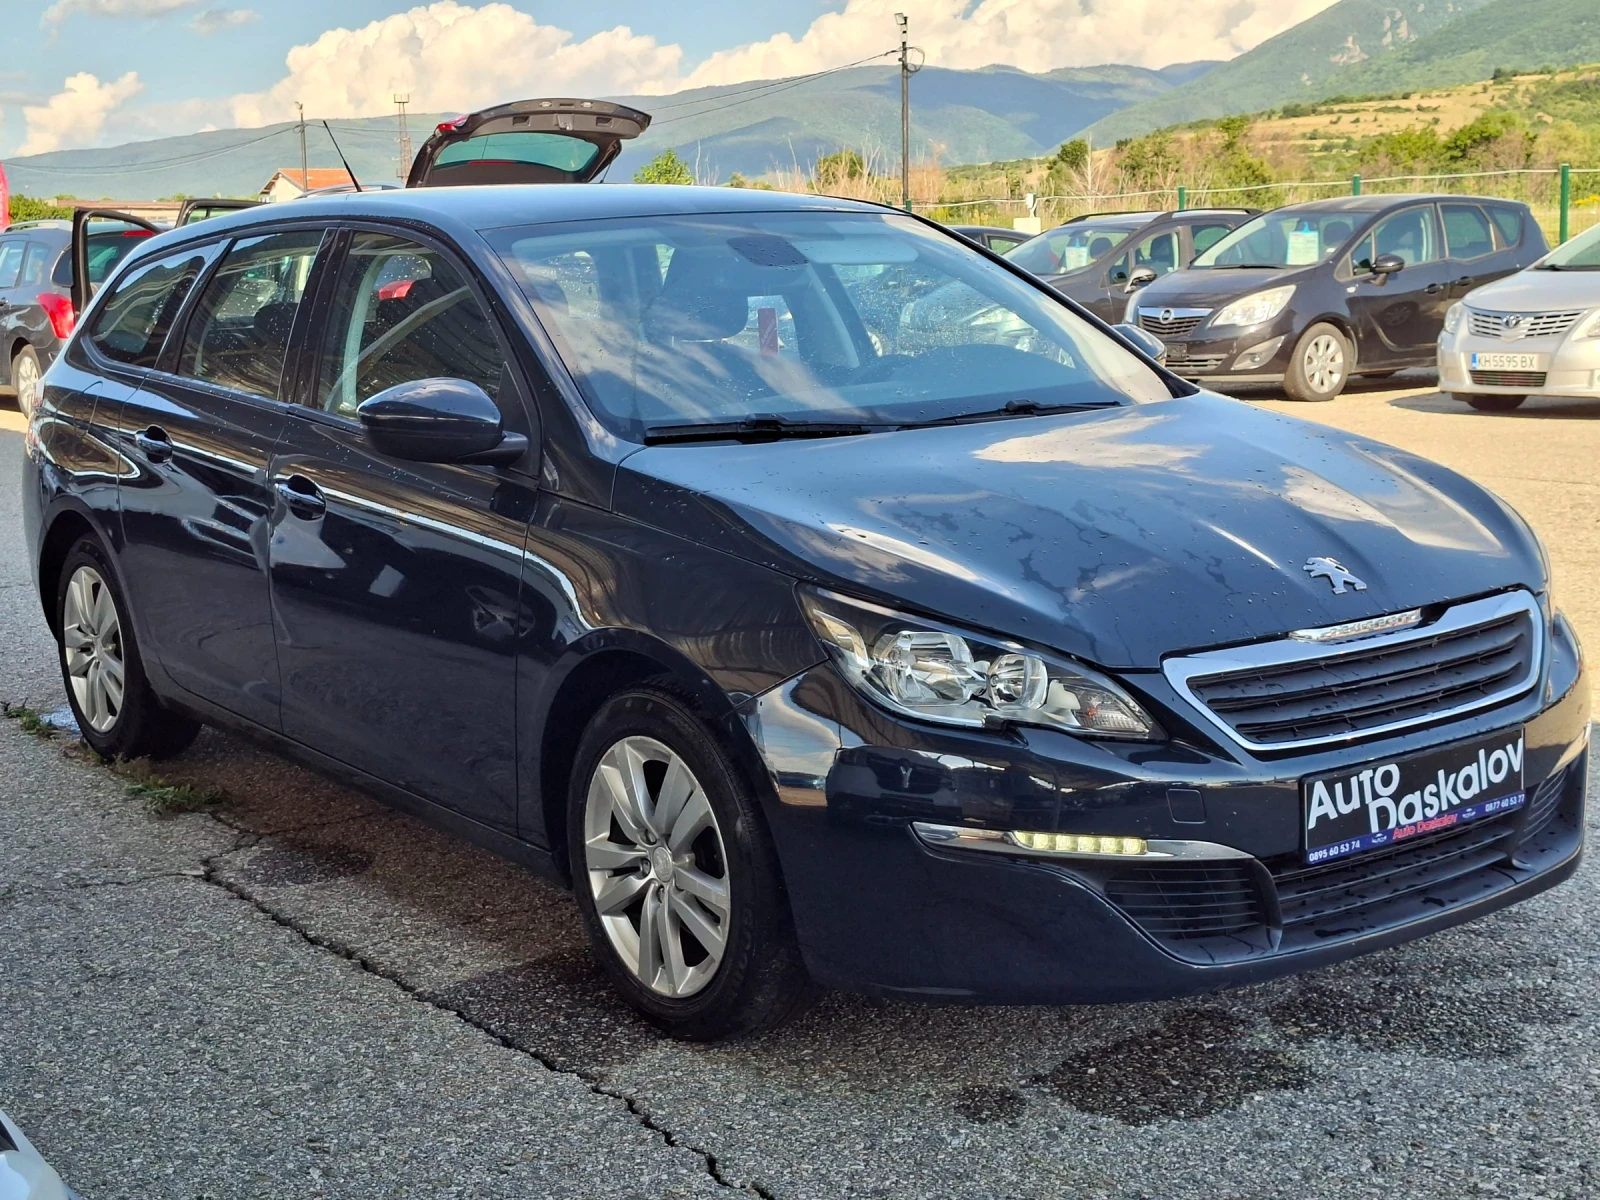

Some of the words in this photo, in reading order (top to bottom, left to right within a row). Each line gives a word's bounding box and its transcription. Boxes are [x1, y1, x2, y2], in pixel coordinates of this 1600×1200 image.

[1367, 738, 1524, 834] Daskalov
[1392, 824, 1416, 840] Auto
[1417, 813, 1458, 833] Daskalov
[1308, 850, 1328, 862] 0895
[1329, 845, 1339, 857] 60
[1340, 842, 1350, 853] 53
[1351, 840, 1361, 850] 74
